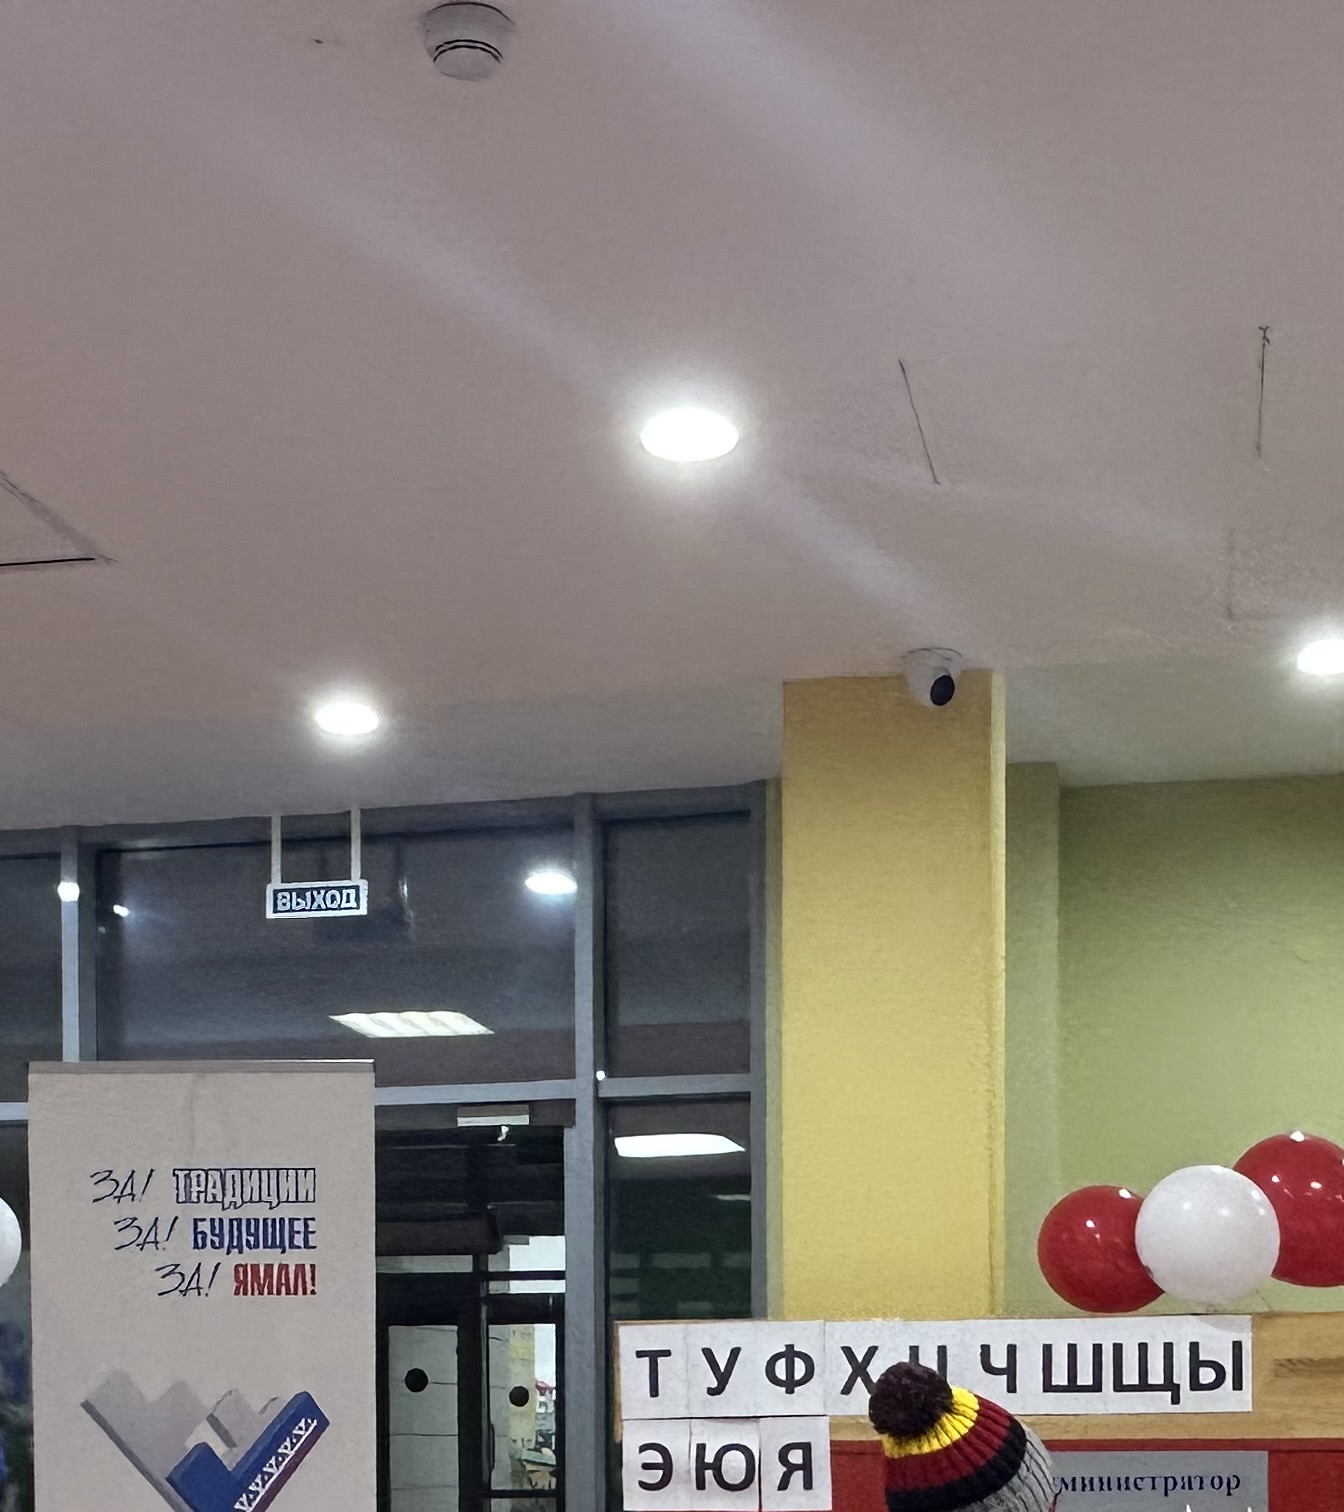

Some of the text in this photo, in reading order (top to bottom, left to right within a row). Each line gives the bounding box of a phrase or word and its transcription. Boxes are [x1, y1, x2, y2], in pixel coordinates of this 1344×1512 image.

[276, 889, 358, 911] ВЫХОД
[90, 1168, 316, 1211] ЗА! ТРАДИЦИИ
[114, 1216, 317, 1255] ЗА! БУДУЩЕЕ
[155, 1262, 317, 1297] ЗА! ЯМАЛ!
[1054, 1475, 1241, 1497] министратор
